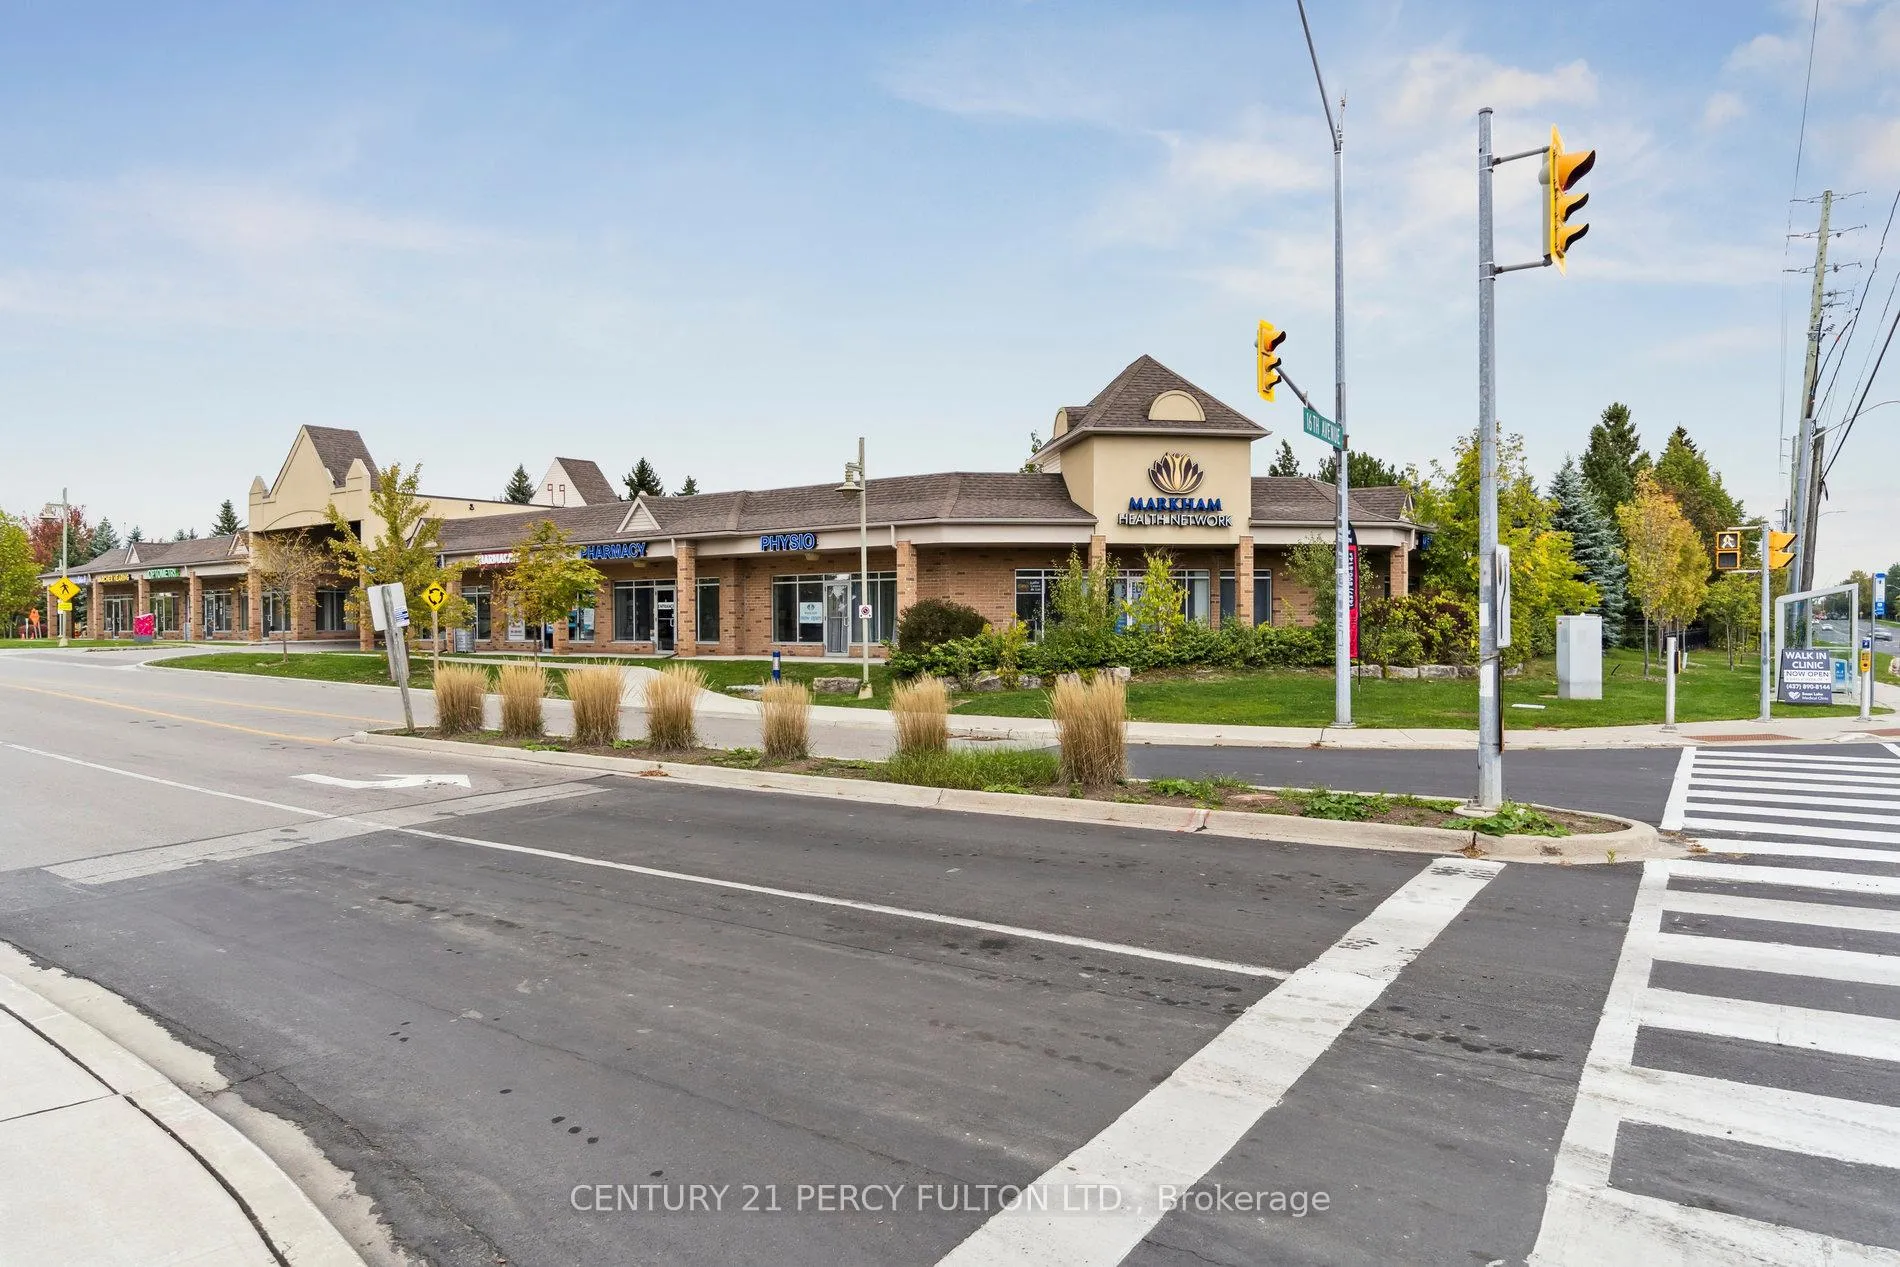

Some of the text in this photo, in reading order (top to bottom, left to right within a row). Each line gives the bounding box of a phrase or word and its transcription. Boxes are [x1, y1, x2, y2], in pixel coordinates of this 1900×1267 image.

[1306, 412, 1340, 445] 16TH AVENUE
[1128, 496, 1223, 511] MARKHAM
[1118, 513, 1233, 527] HEALTH NETWORK
[760, 532, 816, 551] PHYSIO
[579, 541, 646, 560] PHARMACY
[147, 568, 178, 579] OPTOMETRY
[1785, 652, 1827, 660] WALK IN
[1792, 661, 1824, 669] CLINIC
